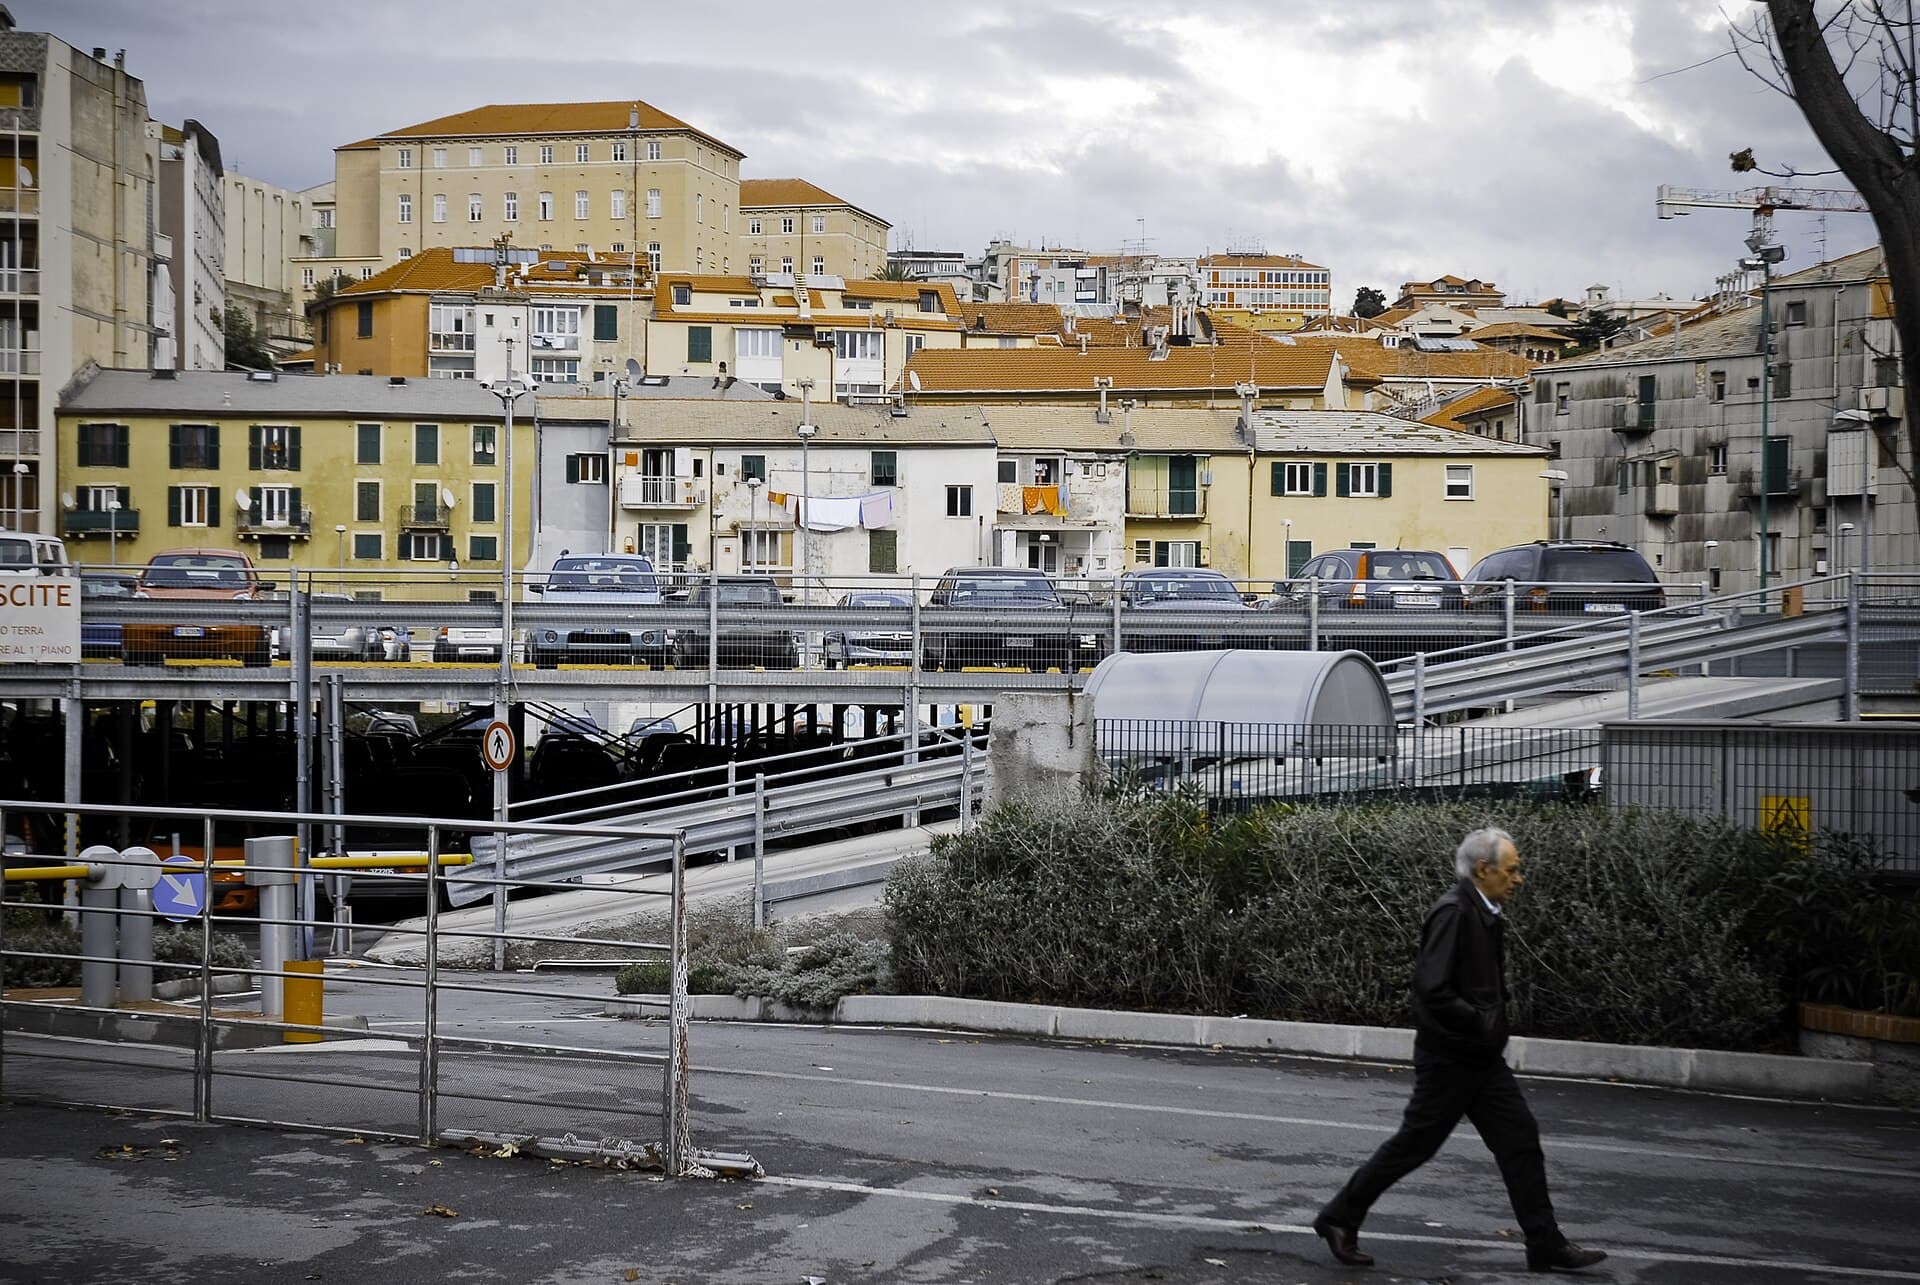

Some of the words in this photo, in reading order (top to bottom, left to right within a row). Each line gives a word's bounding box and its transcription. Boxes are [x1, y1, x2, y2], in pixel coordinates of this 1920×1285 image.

[11, 625, 44, 635] TERRA
[14, 645, 25, 654] AL
[41, 645, 72, 654] PIANO
